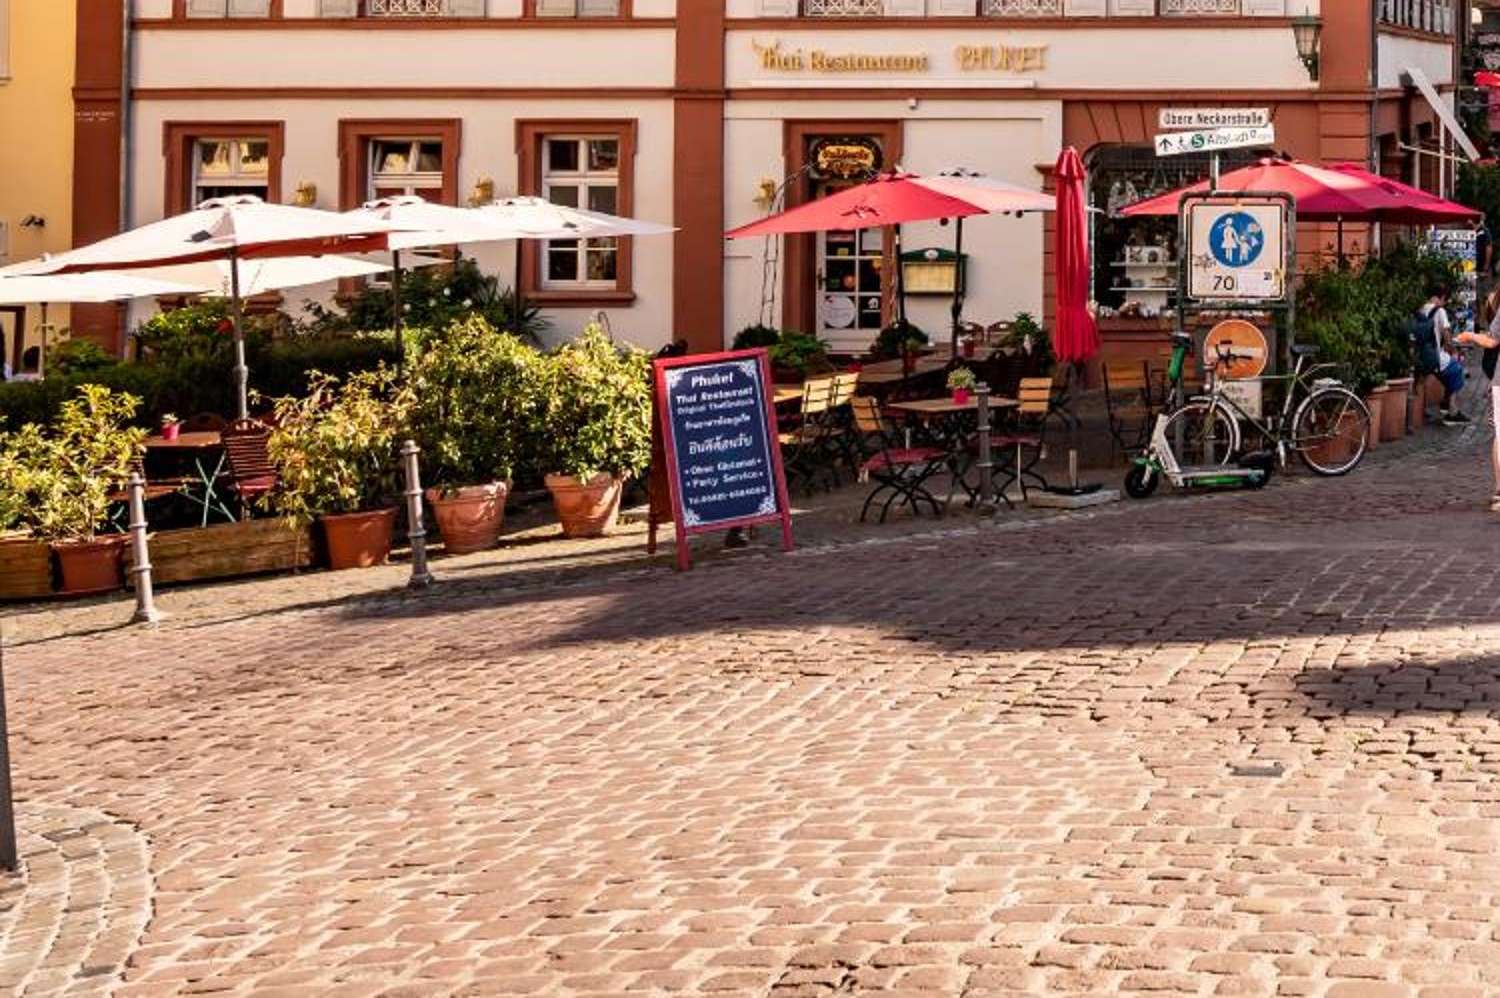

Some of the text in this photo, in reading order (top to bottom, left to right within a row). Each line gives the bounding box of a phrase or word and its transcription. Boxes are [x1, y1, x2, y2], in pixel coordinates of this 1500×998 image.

[811, 49, 929, 73] Restaurant
[955, 44, 1050, 73] PHUKET
[1164, 111, 1263, 124] Obere Neckarstraße
[691, 371, 734, 388] Phuket
[675, 386, 753, 405] Thai Restaurant
